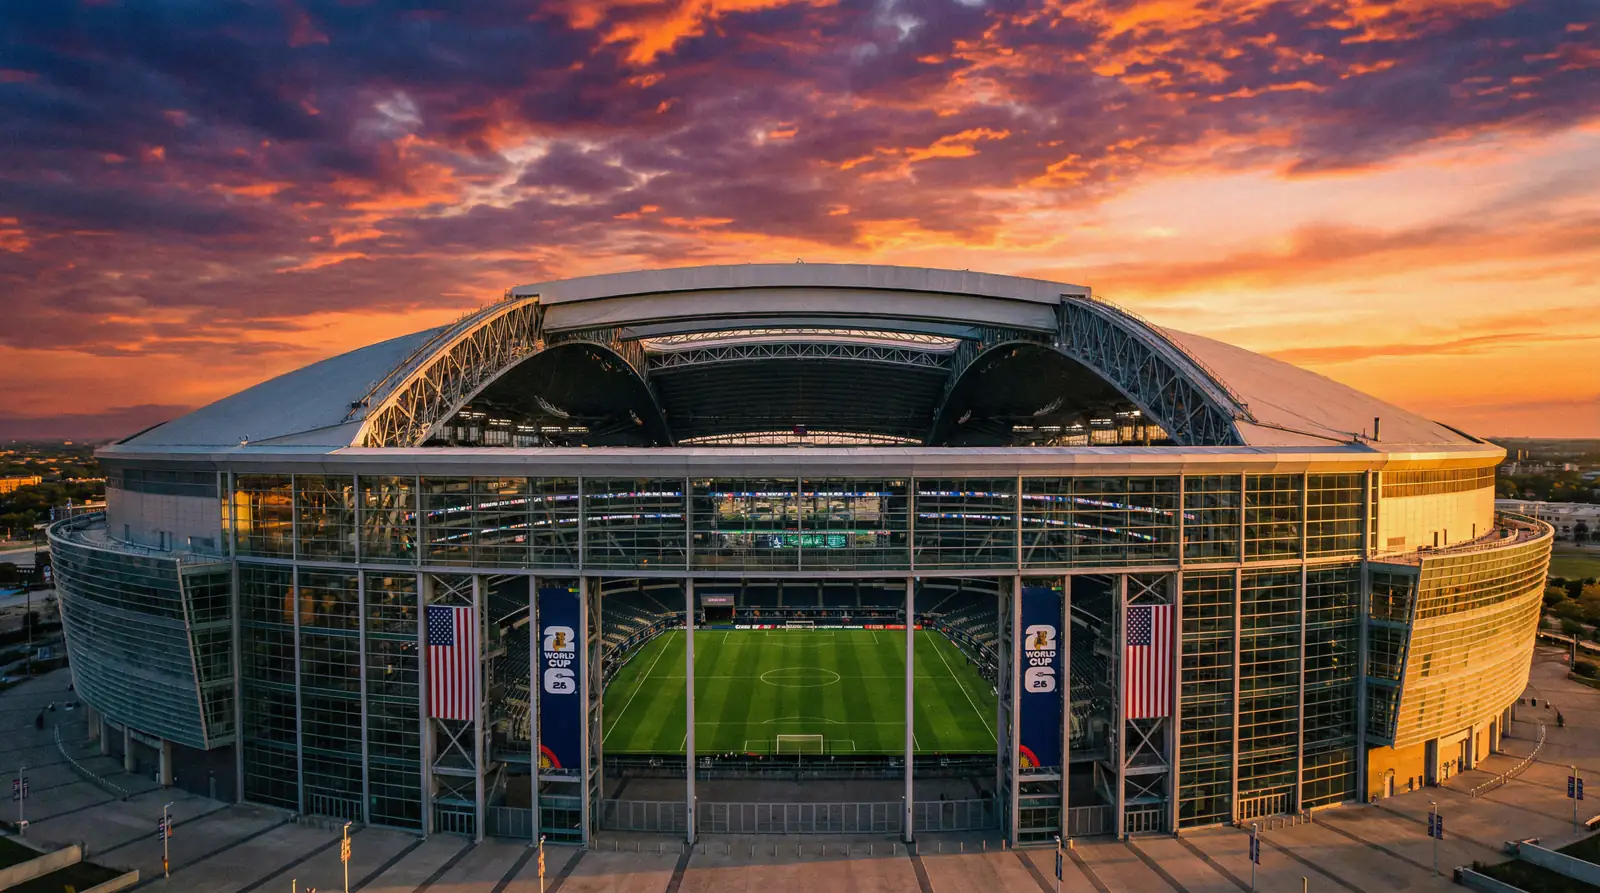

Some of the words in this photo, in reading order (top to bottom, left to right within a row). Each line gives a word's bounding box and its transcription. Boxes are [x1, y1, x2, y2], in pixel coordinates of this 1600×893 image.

[545, 652, 575, 660] WORLD
[1029, 658, 1052, 666] CUP
[544, 667, 575, 694] 6
[1025, 666, 1056, 693] 6
[1033, 680, 1047, 688] 26
